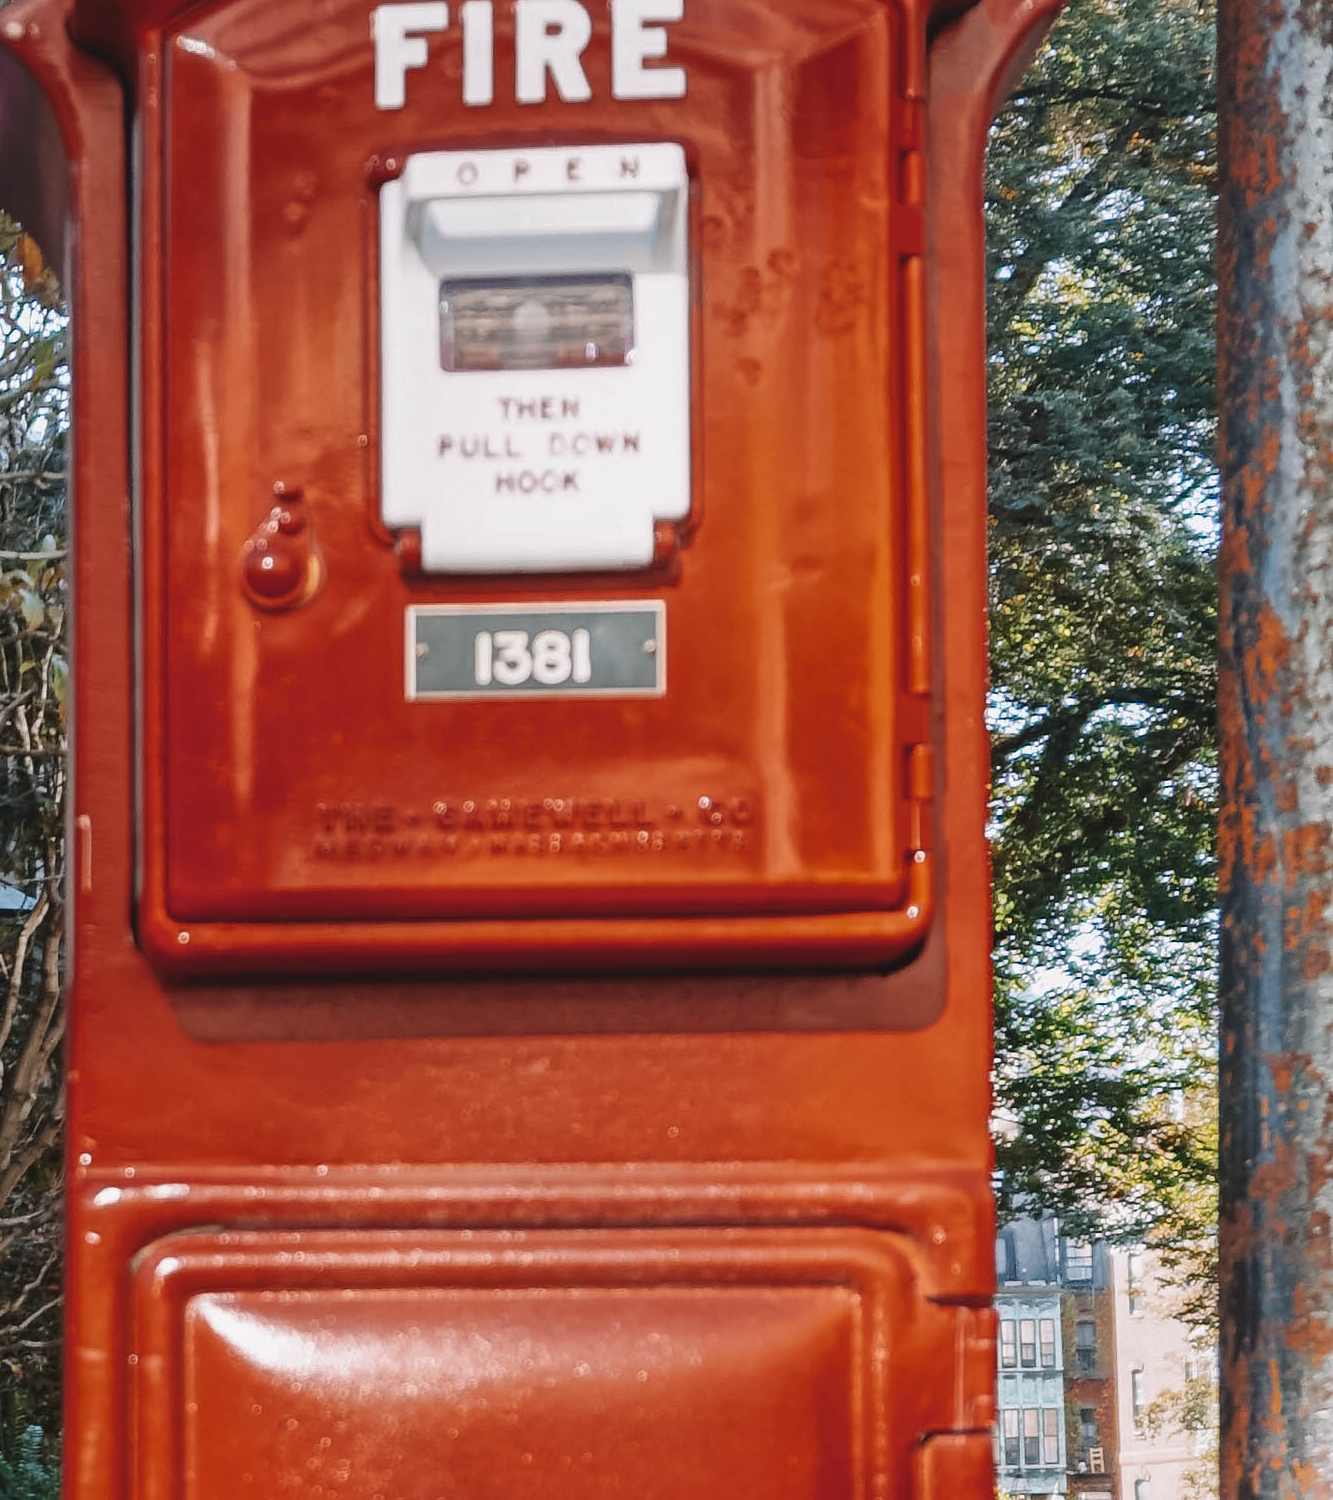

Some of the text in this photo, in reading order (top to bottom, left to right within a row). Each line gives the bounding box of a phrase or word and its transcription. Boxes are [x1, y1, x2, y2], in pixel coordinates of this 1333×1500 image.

[456, 155, 640, 185] OPEN
[497, 395, 581, 420] THEN
[437, 429, 640, 458] PULL DOWN
[494, 469, 580, 494] HOOK
[474, 627, 592, 686] 1381
